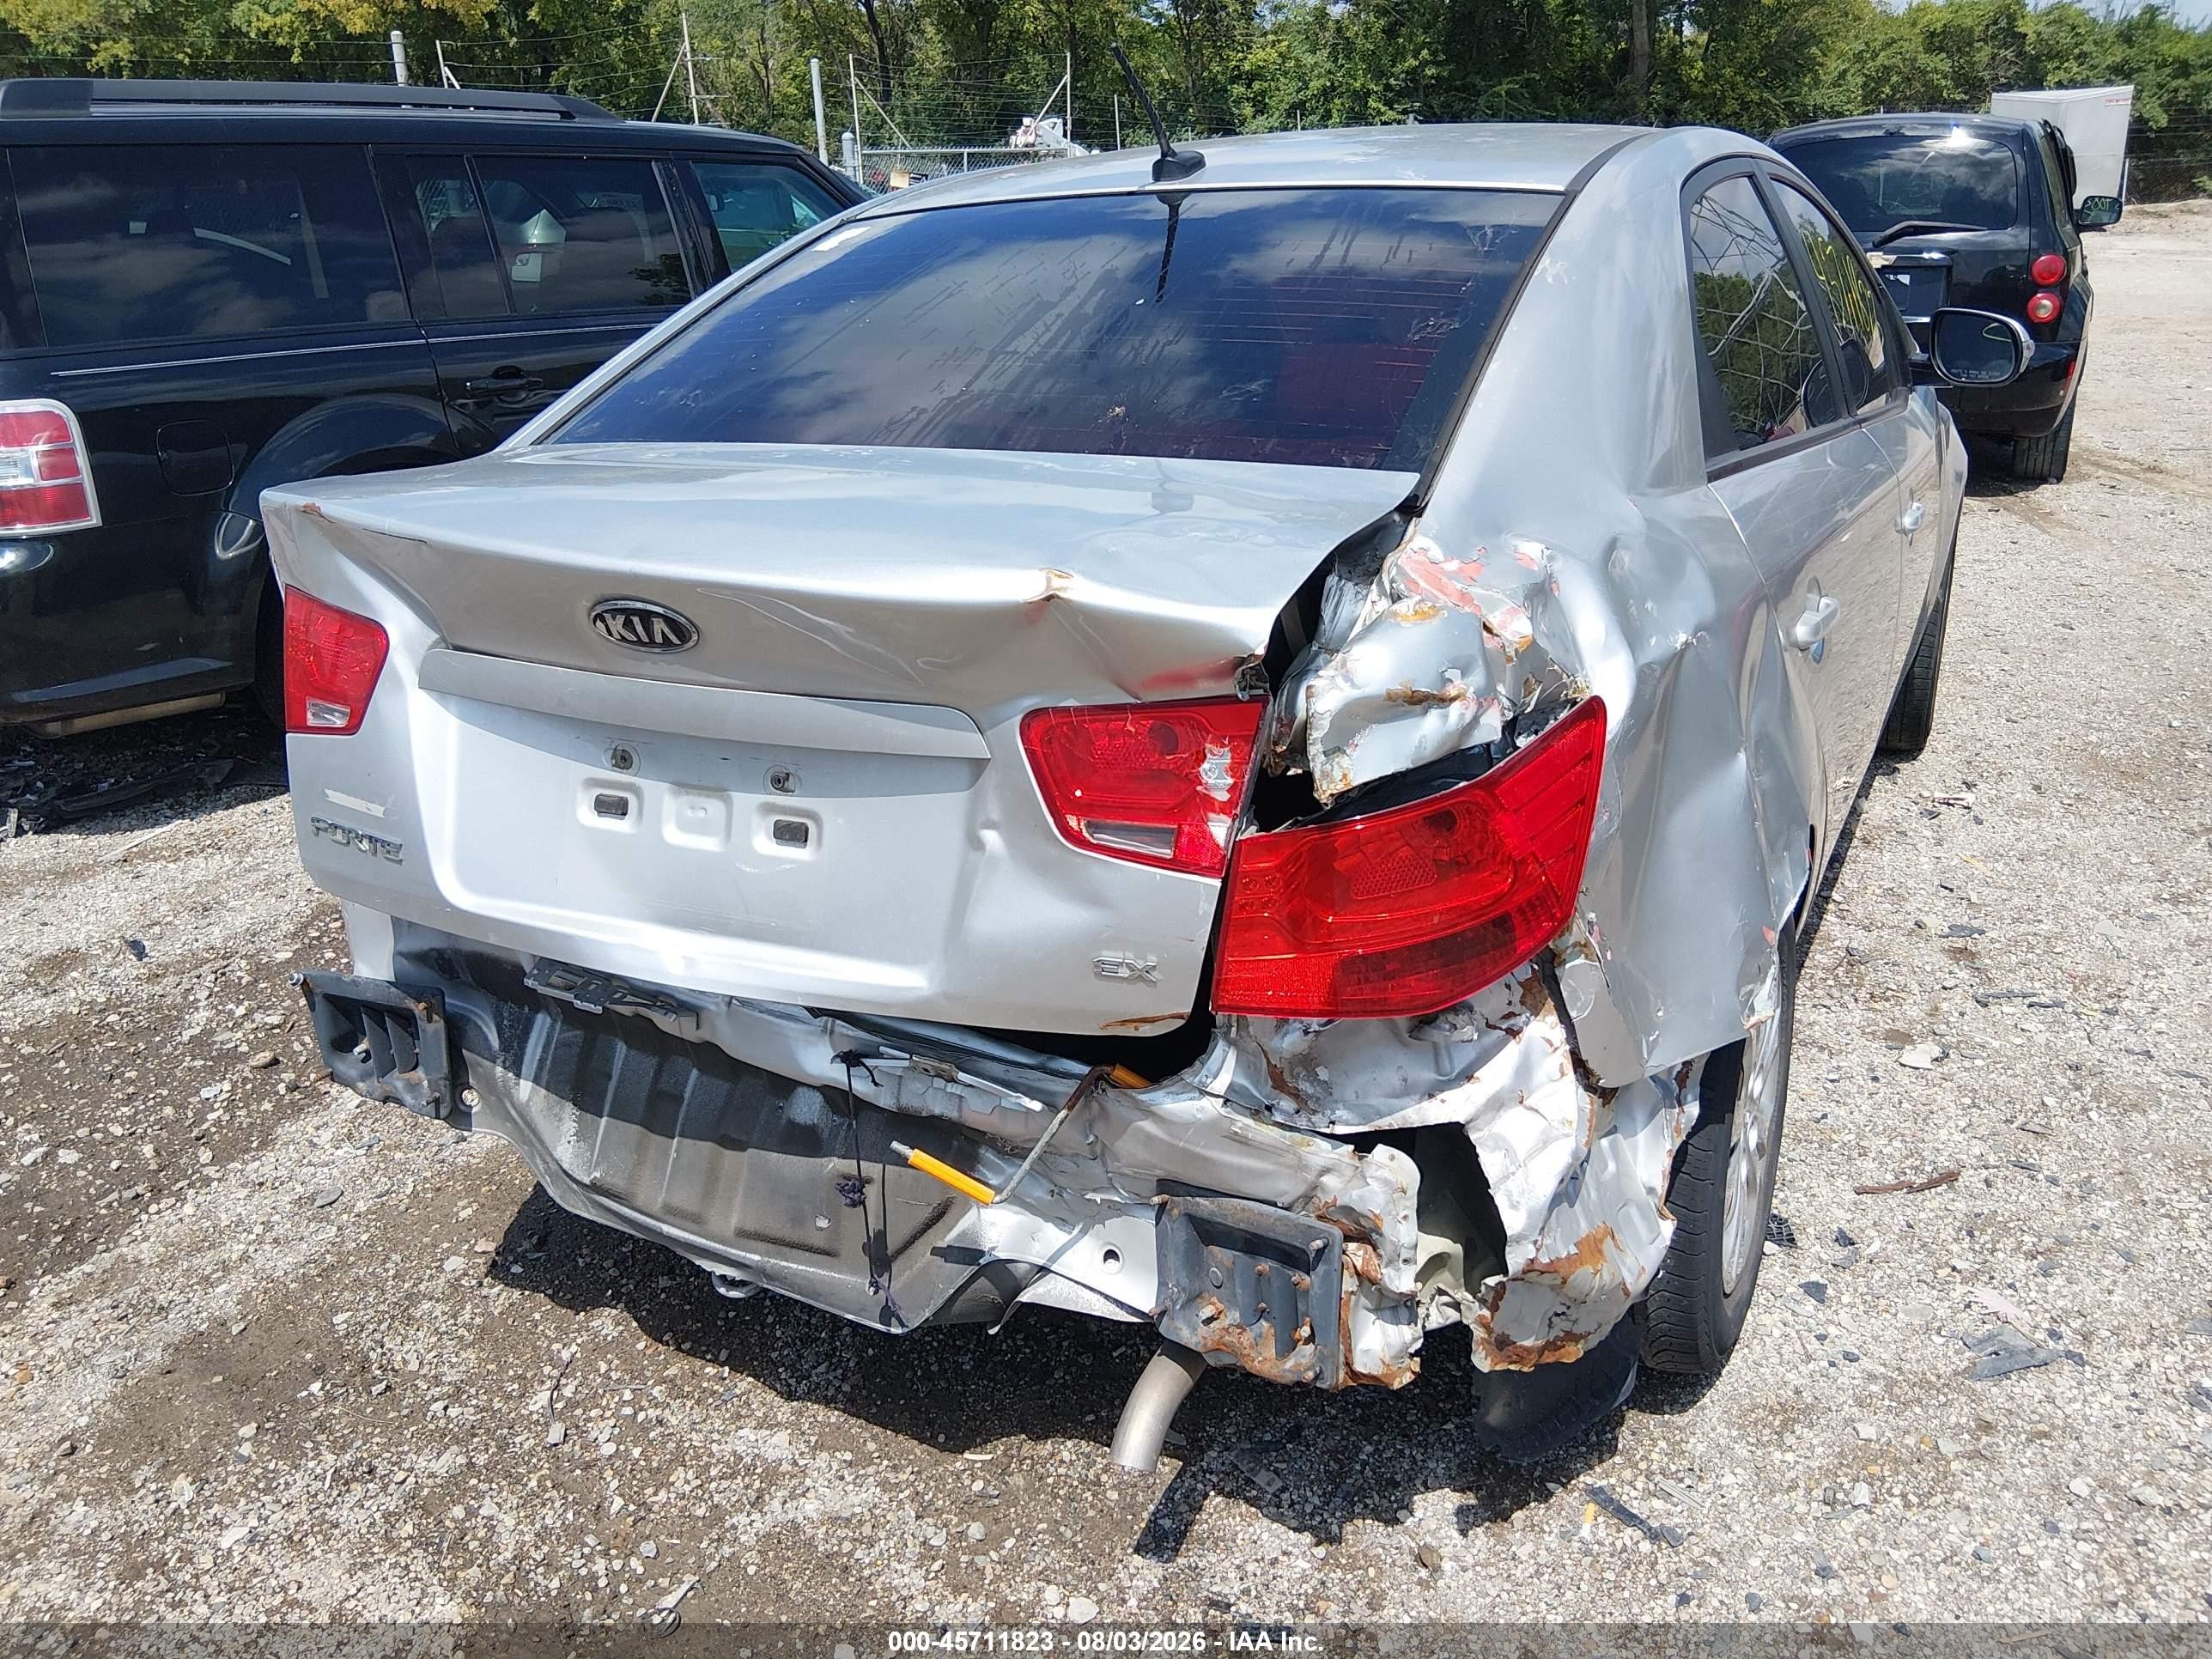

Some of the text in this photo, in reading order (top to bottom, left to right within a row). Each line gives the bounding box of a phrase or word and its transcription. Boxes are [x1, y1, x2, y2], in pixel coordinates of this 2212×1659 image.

[601, 612, 683, 646] KIA
[310, 817, 404, 866] FORTE
[1092, 956, 1158, 984] EX
